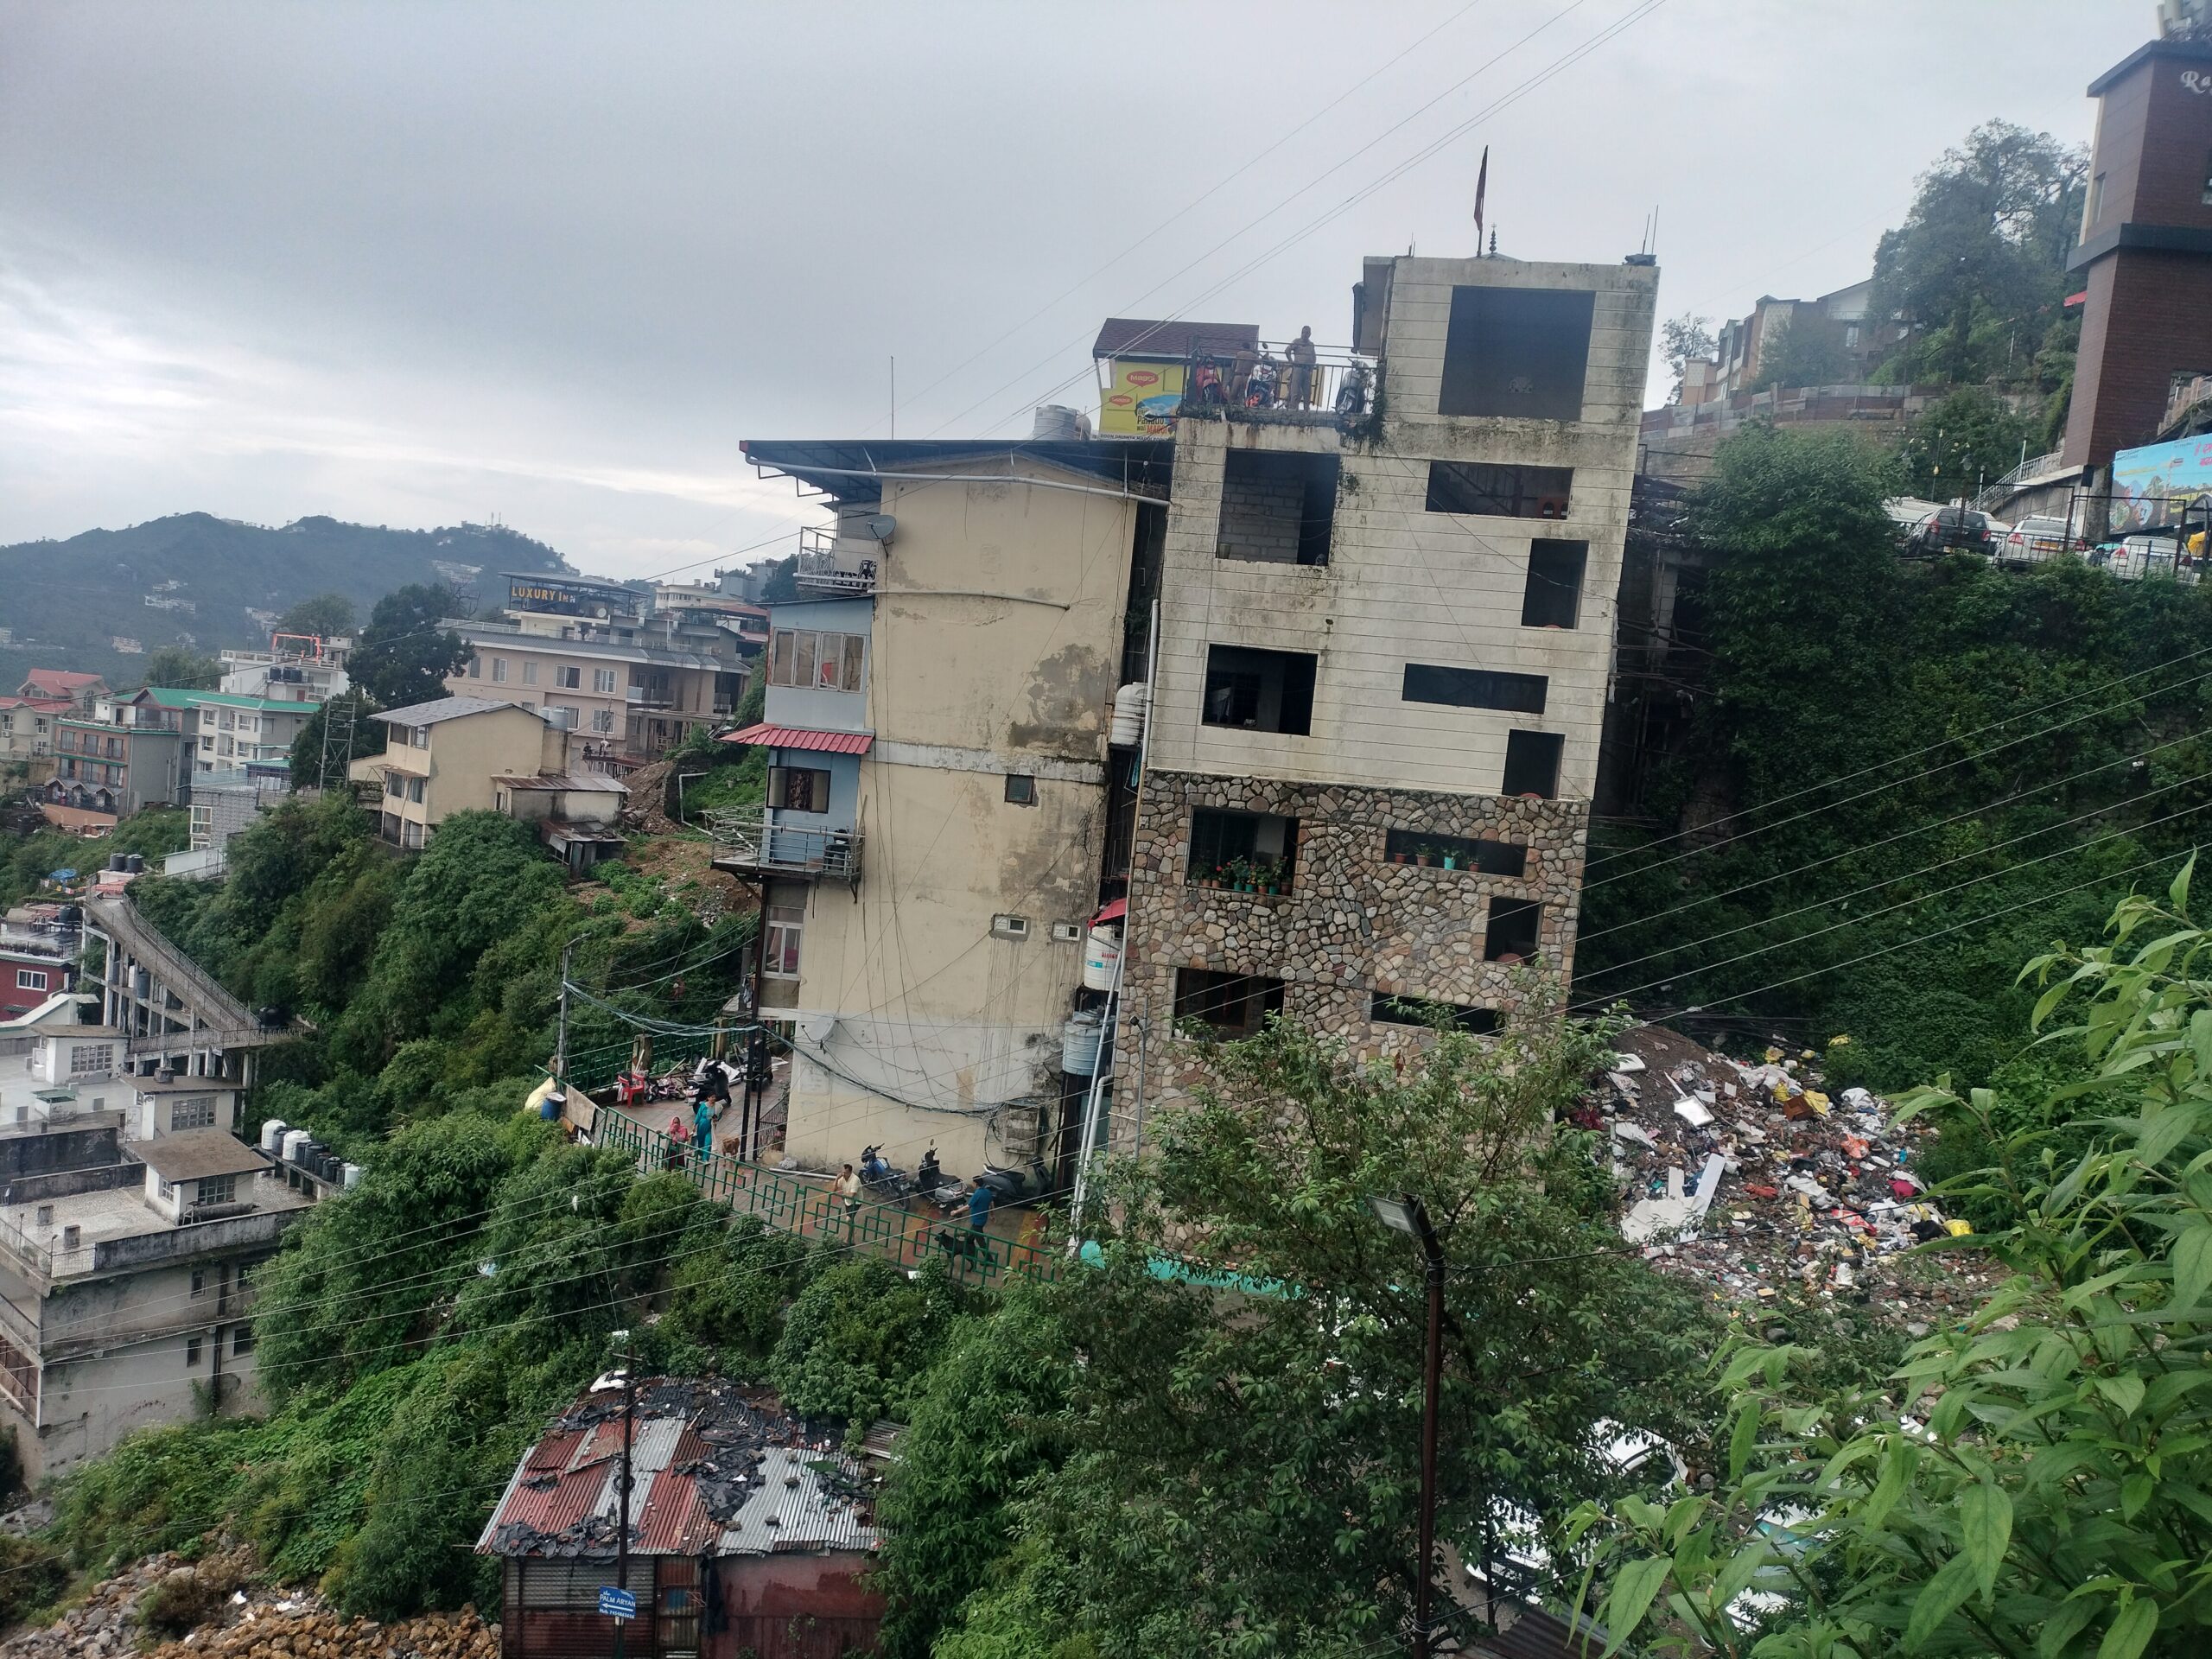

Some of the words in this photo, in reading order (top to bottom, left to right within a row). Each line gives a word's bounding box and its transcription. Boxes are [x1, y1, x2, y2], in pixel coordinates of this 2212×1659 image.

[512, 586, 556, 601] LUXURY
[600, 1594, 615, 1604] PALM
[616, 1598, 636, 1607] ARYAN
